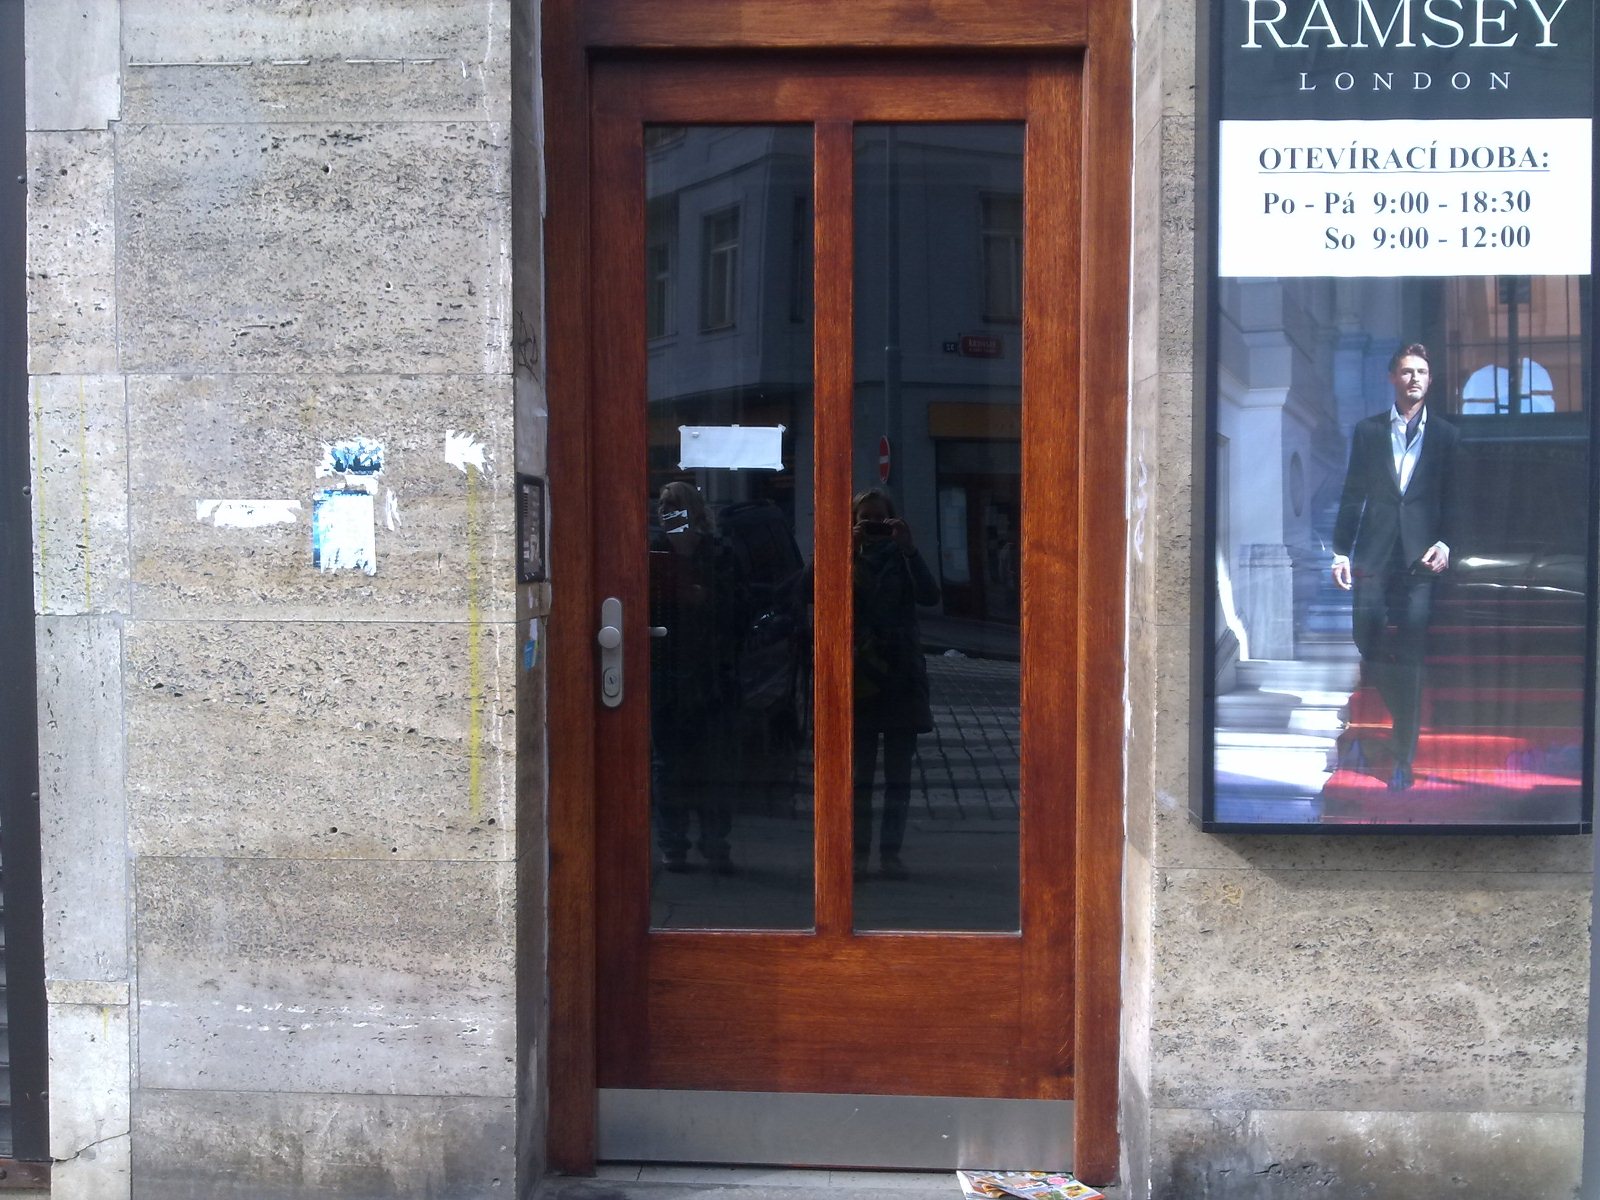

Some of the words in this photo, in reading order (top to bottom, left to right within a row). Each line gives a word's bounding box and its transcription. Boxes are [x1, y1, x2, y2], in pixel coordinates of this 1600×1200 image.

[1240, 0, 1569, 49] RAMSEY
[1299, 71, 1512, 91] LONDON
[1258, 140, 1438, 171] OTEVÍRACÍ
[1449, 146, 1550, 170] DOBA:
[1263, 192, 1296, 215] Po
[1324, 191, 1356, 215] Pá
[1373, 191, 1430, 215] 9:00
[1460, 190, 1532, 214] 18:30
[1324, 227, 1356, 250] So
[1372, 226, 1430, 250] 9:00
[1460, 225, 1532, 249] 12:00
